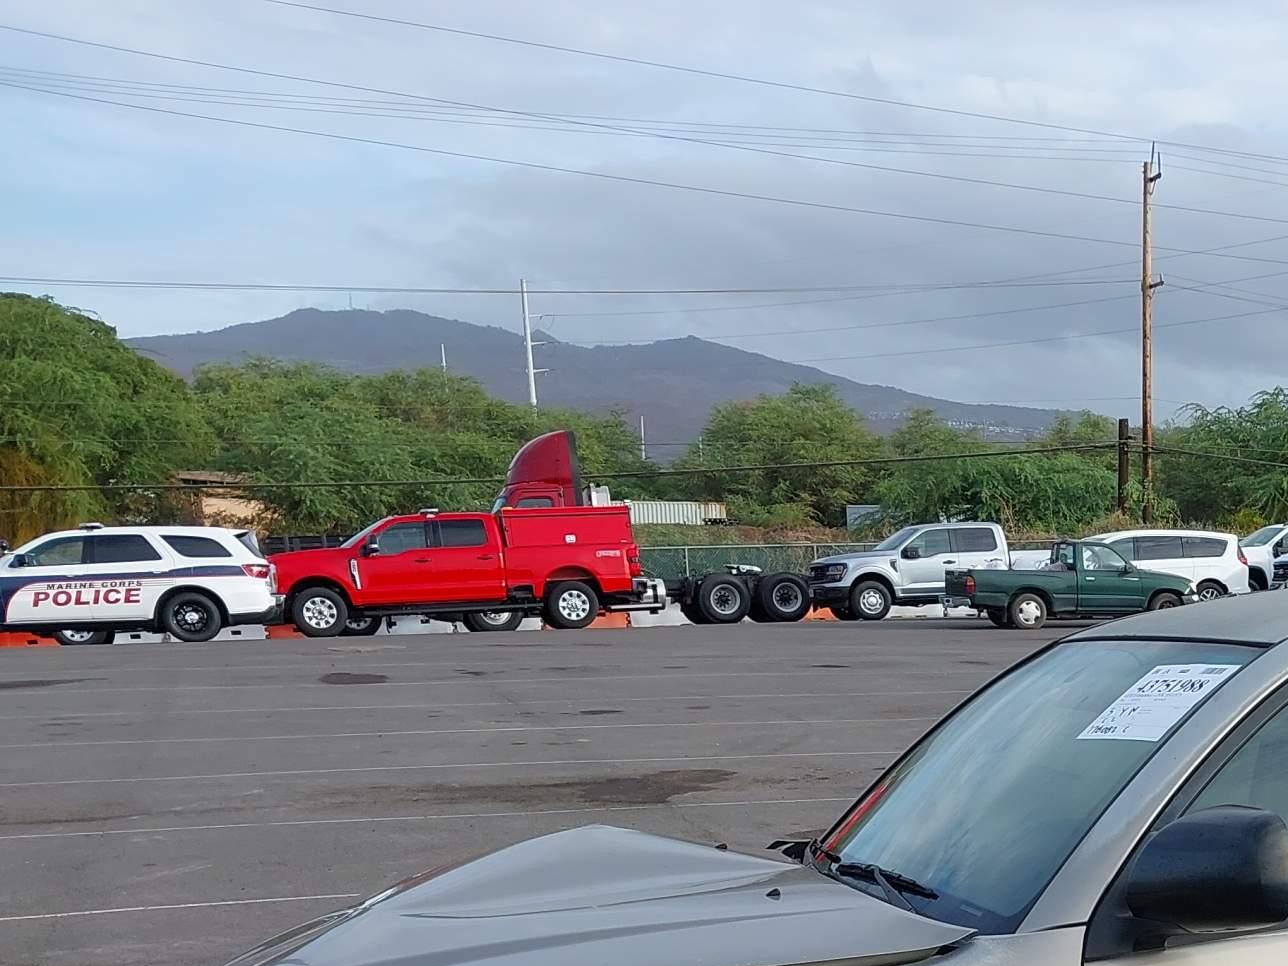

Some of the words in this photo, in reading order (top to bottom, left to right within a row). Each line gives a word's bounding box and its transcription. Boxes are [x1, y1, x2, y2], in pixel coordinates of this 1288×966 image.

[45, 582, 96, 590] MARINE
[101, 580, 143, 589] CORPS
[32, 587, 142, 607] POLICE
[1137, 679, 1211, 693] 43751988
